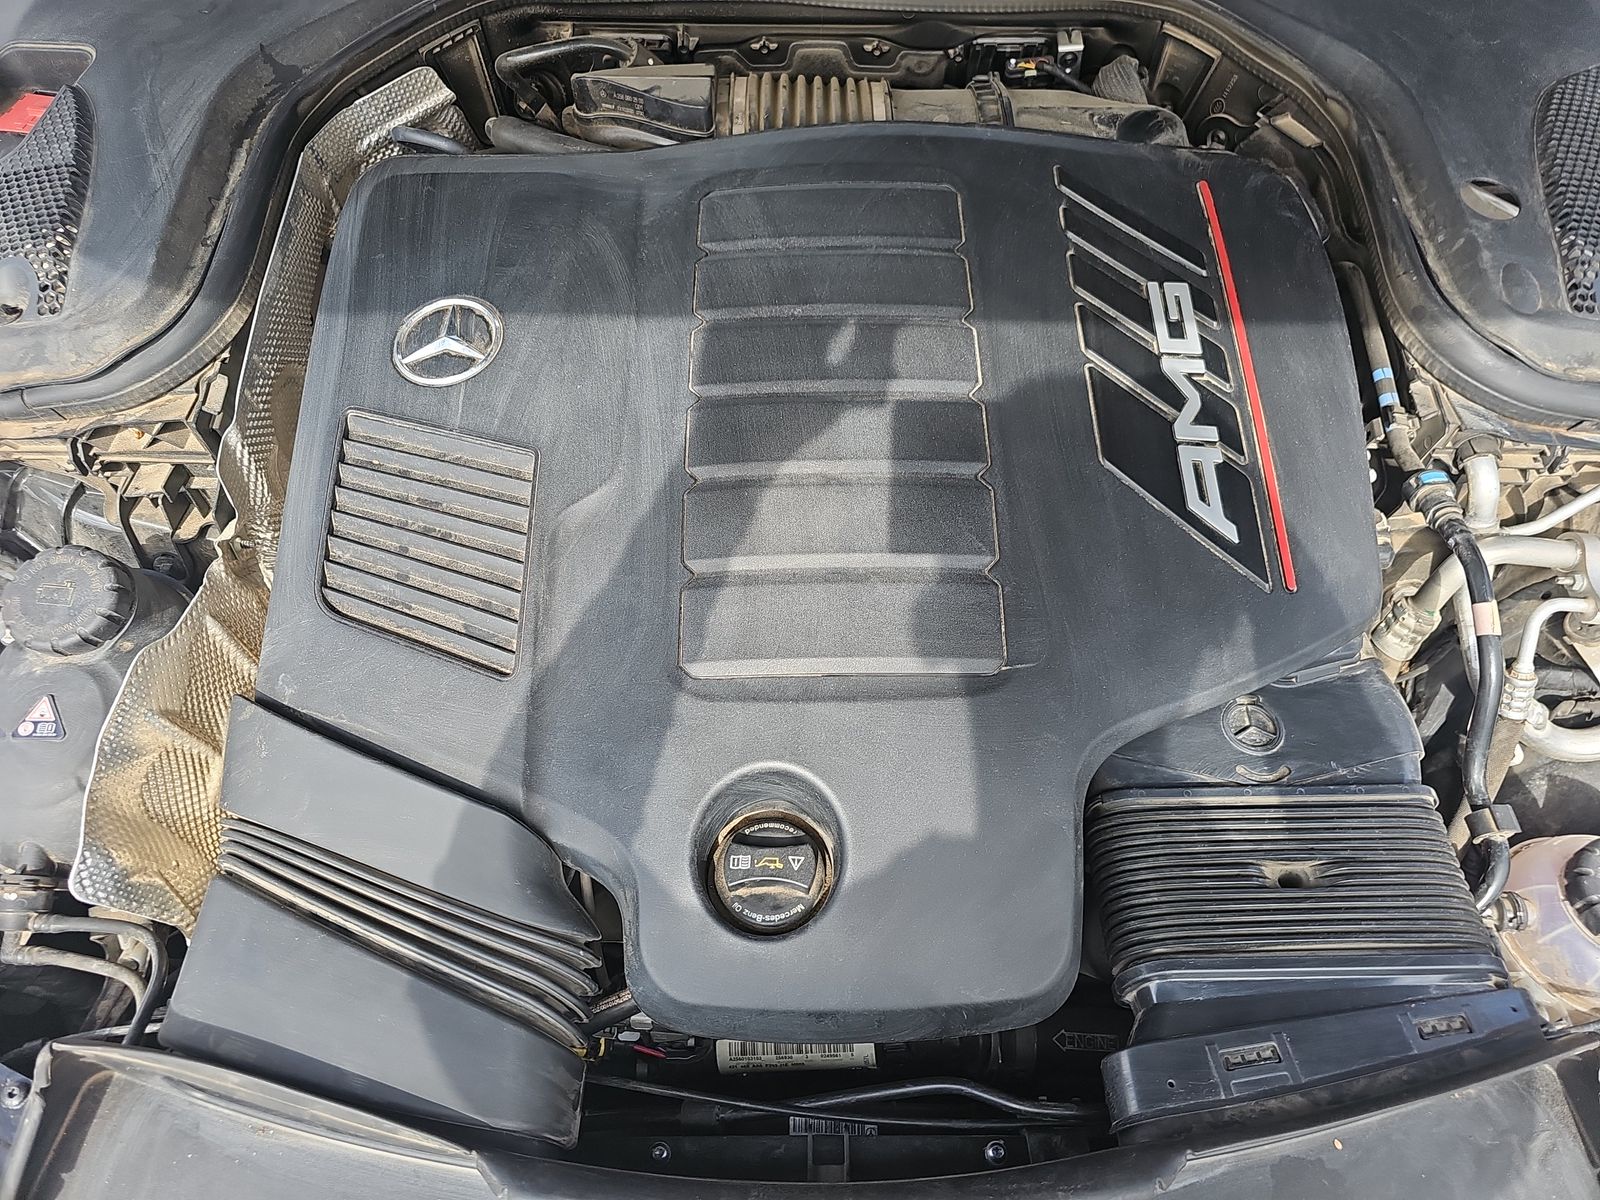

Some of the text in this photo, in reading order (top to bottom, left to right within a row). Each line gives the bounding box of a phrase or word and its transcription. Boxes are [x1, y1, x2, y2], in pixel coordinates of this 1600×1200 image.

[1147, 281, 1240, 543] AMG
[744, 822, 798, 835] recommended
[731, 902, 806, 922] Mercedes-Benz Oil
[1065, 1033, 1116, 1049] ENGINE
